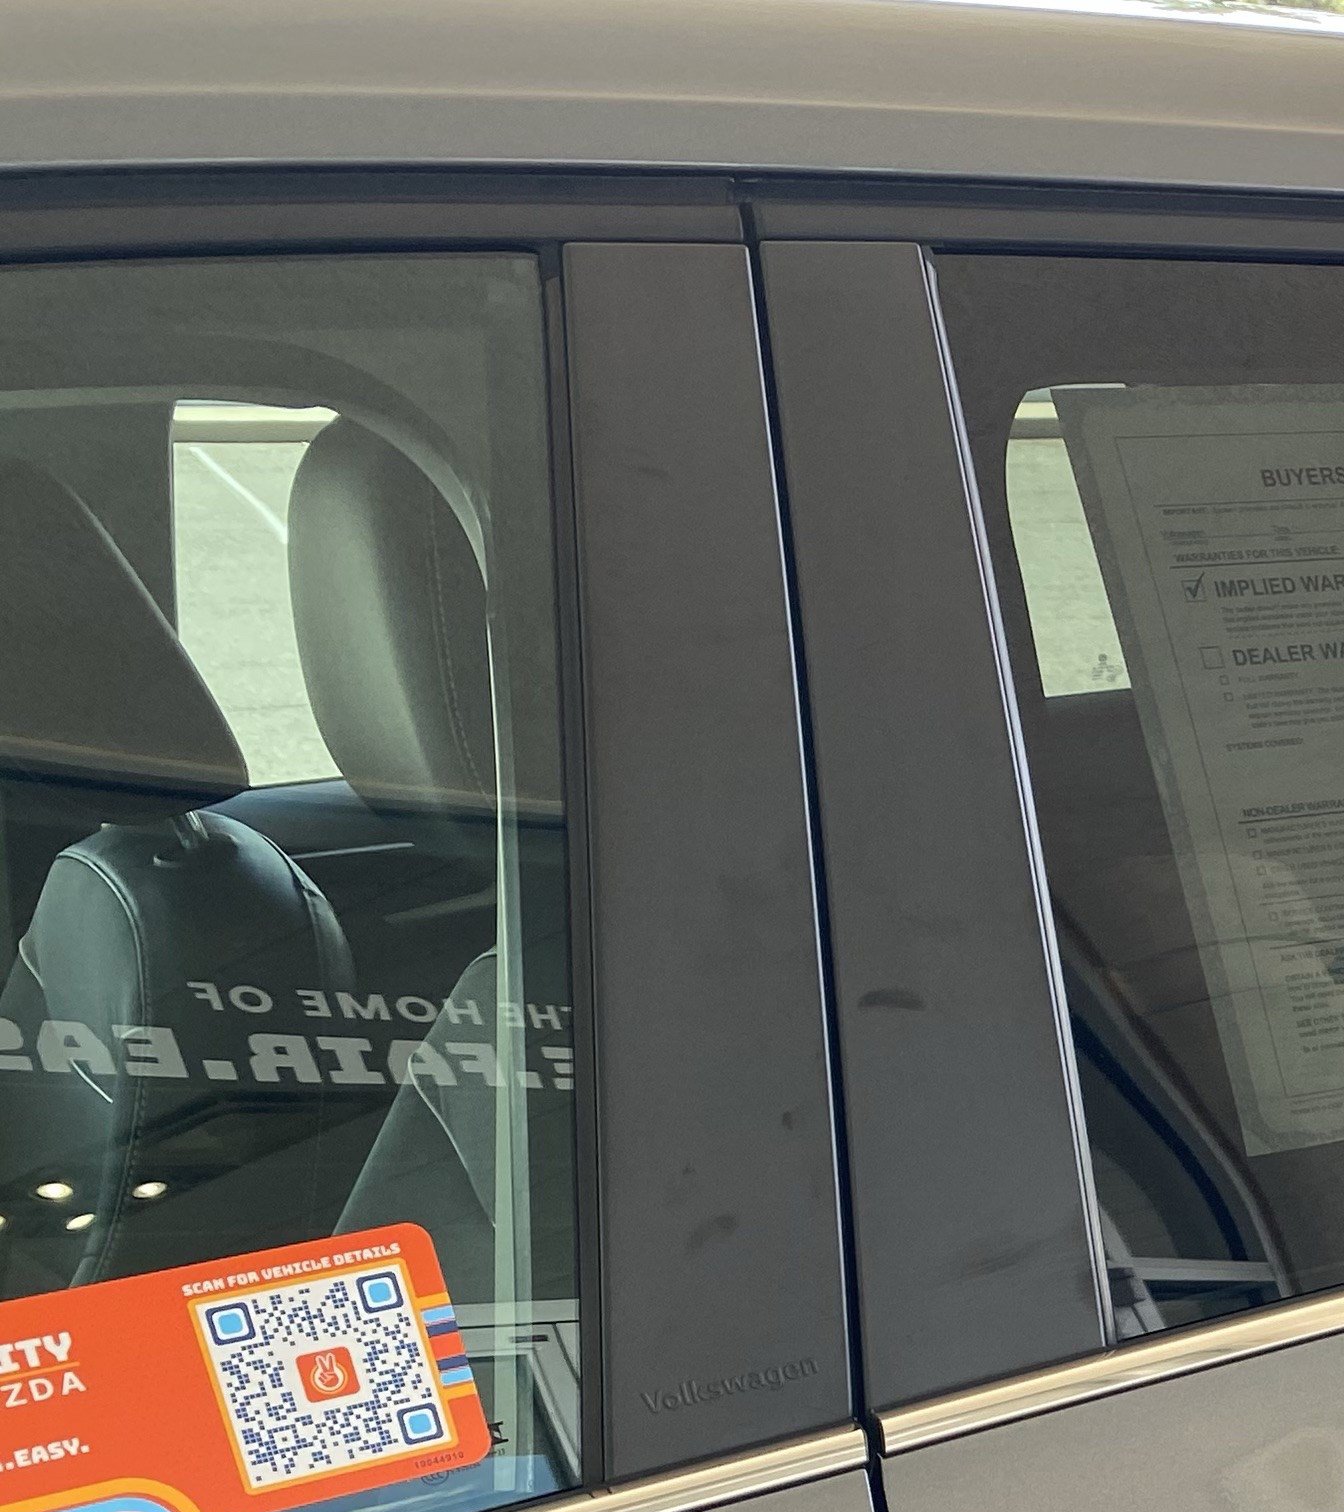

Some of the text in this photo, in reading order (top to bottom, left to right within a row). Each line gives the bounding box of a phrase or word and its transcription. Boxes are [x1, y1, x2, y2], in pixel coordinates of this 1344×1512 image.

[1213, 576, 1297, 598] IMPLIED
[1231, 644, 1316, 667] DEALER
[182, 1242, 402, 1298] SCAN FOR VEHICLE DETAILS
[640, 1357, 819, 1414] Volkswagen
